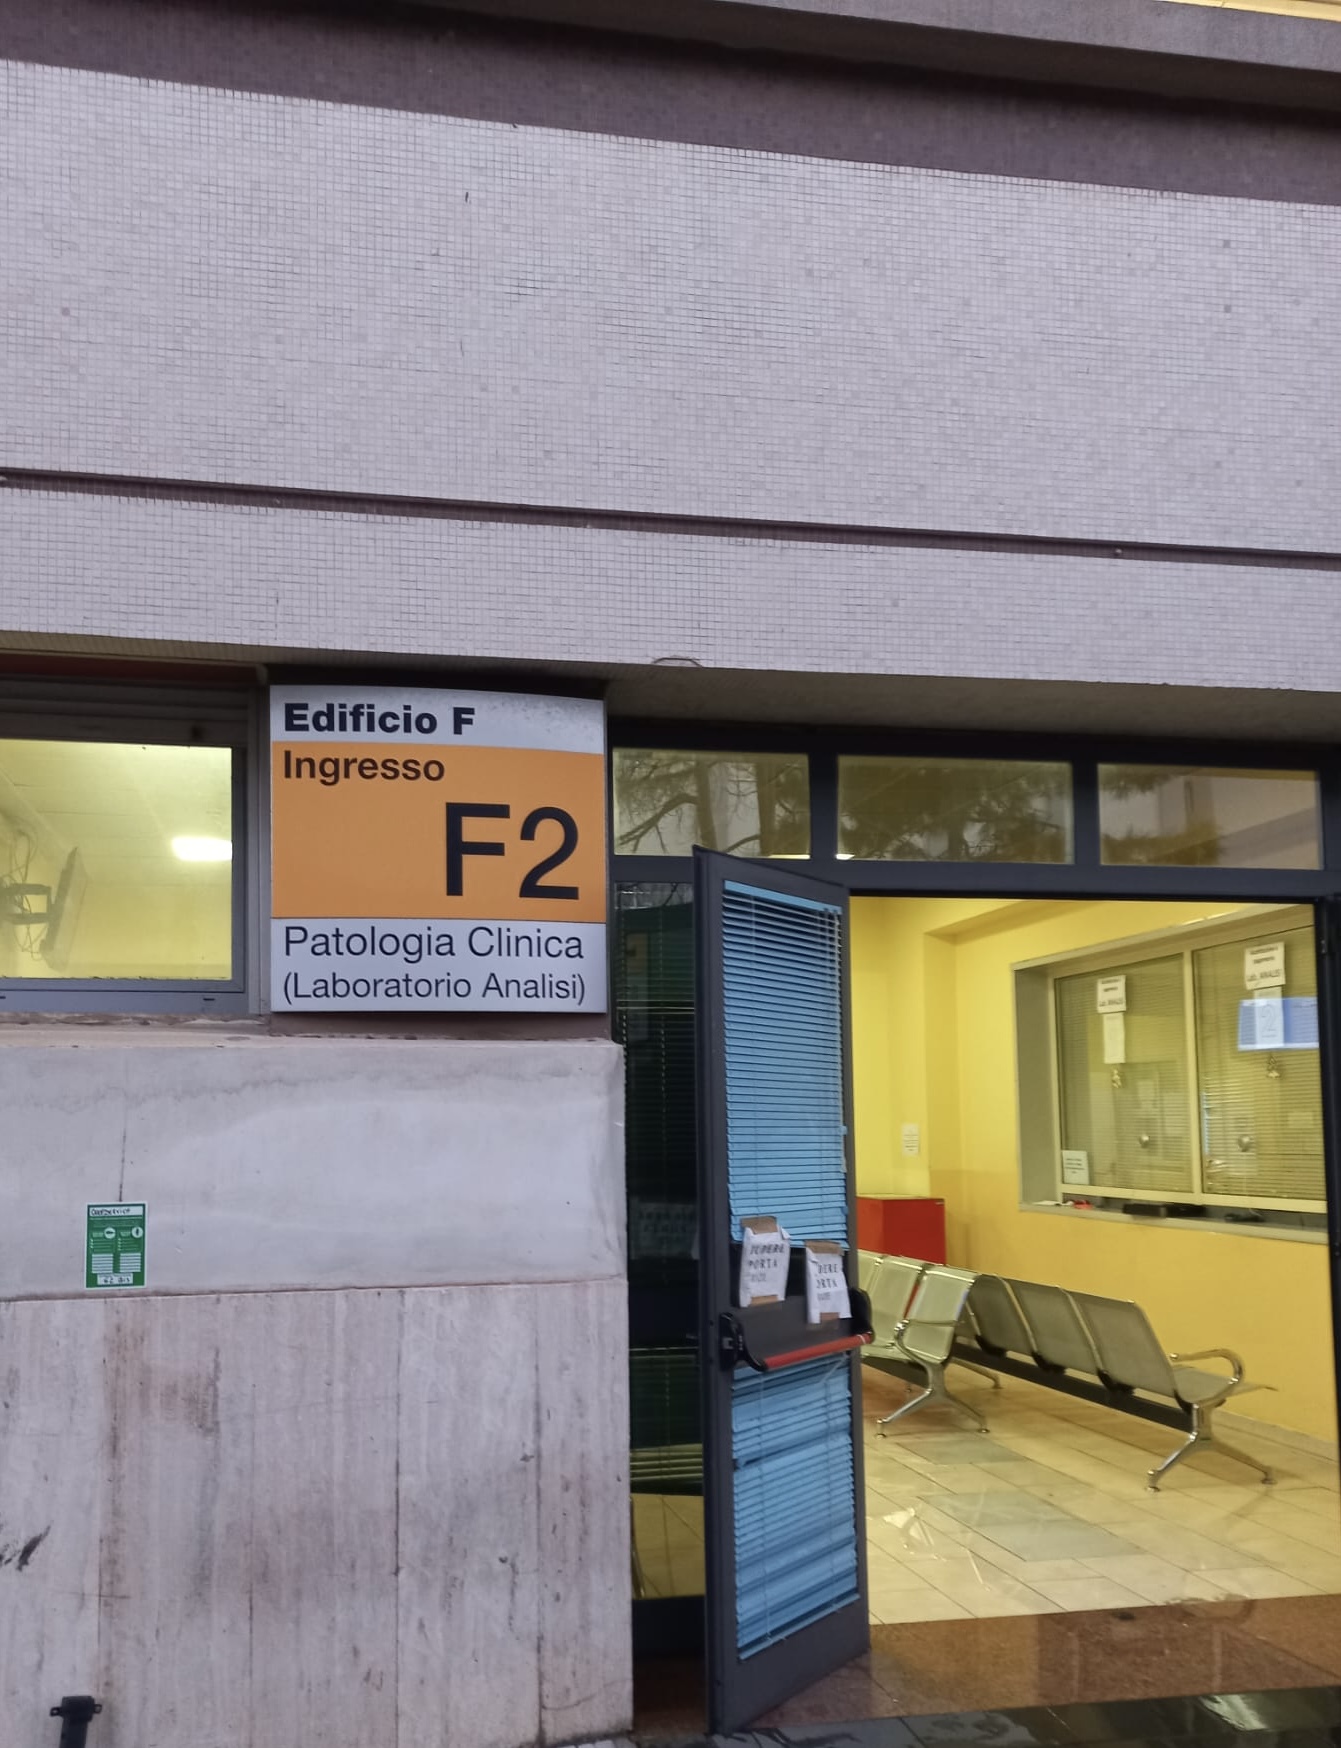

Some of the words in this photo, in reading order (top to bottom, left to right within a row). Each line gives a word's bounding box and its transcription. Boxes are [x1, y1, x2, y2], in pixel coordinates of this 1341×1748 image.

[284, 702, 437, 734] Edificio
[453, 707, 475, 735] F
[284, 750, 444, 786] Ingresso
[446, 802, 579, 900] F2
[286, 926, 455, 964] Patologia
[468, 927, 584, 958] Clinica
[284, 972, 471, 1005] (Laboratorio
[482, 973, 585, 1005] Analisi)
